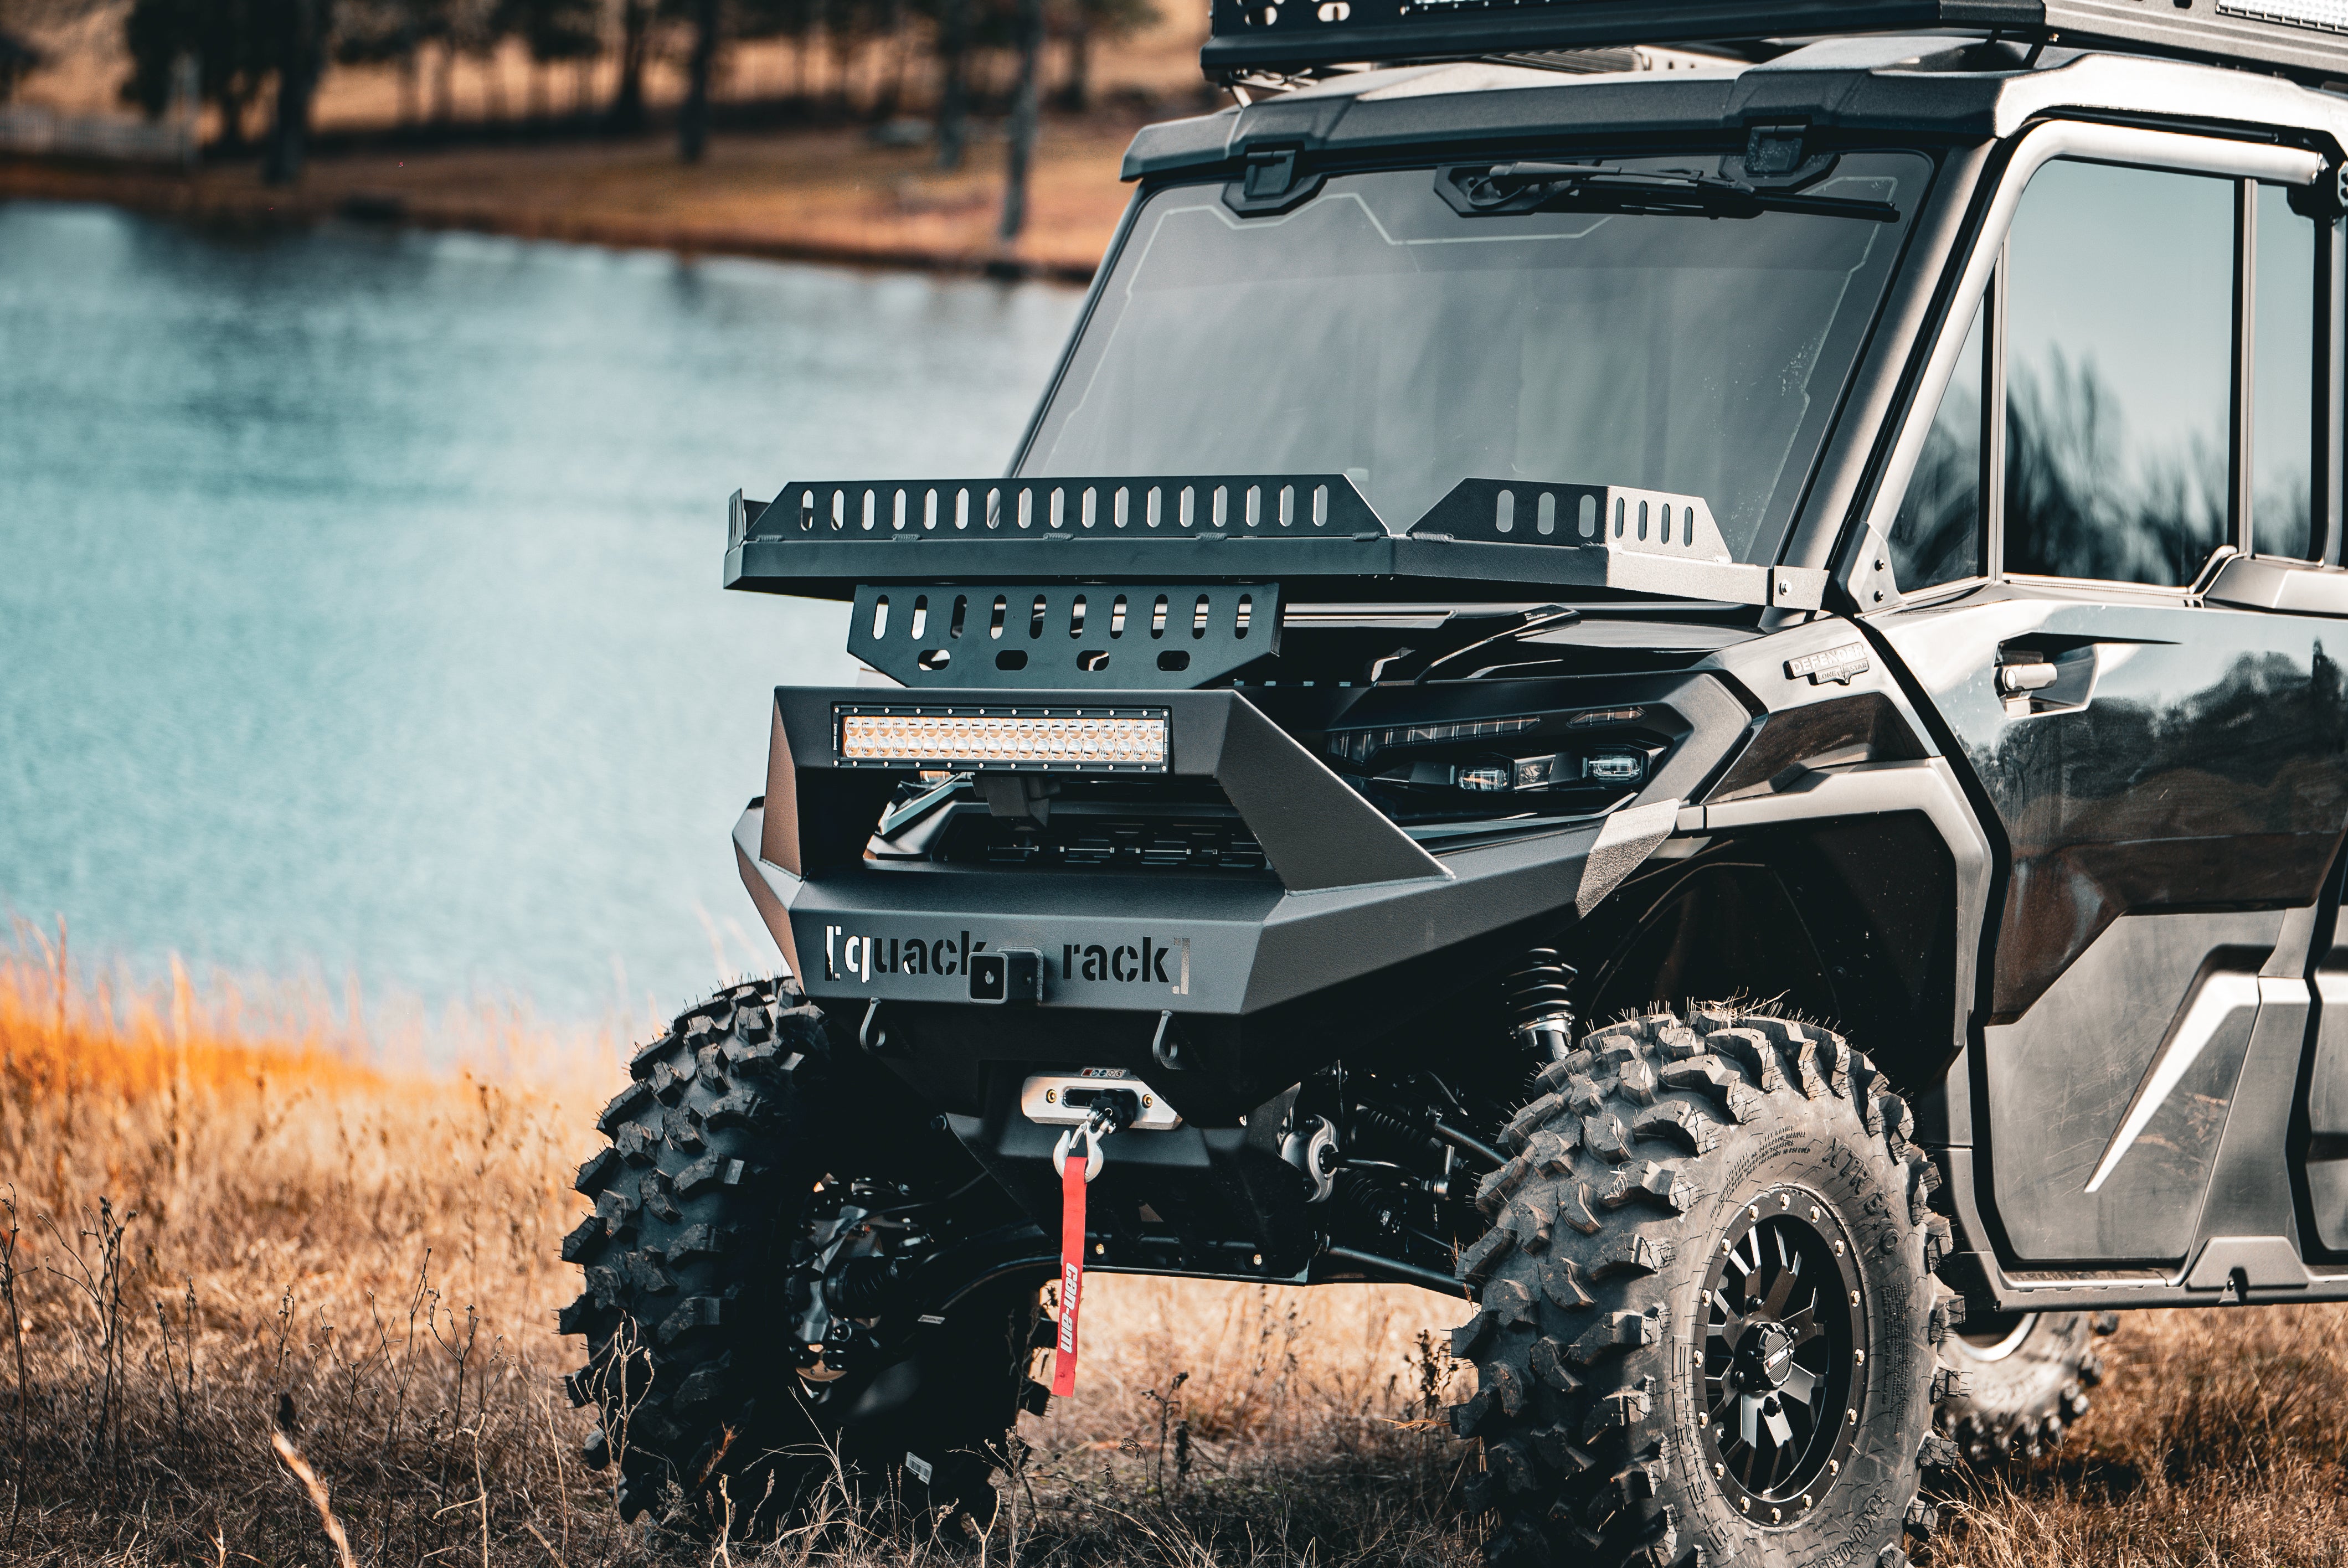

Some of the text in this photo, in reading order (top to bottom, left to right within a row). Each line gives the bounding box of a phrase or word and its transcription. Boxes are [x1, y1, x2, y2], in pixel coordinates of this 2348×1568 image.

[1791, 644, 1866, 673] DEFENDER
[1817, 663, 1867, 680] LONE STAR
